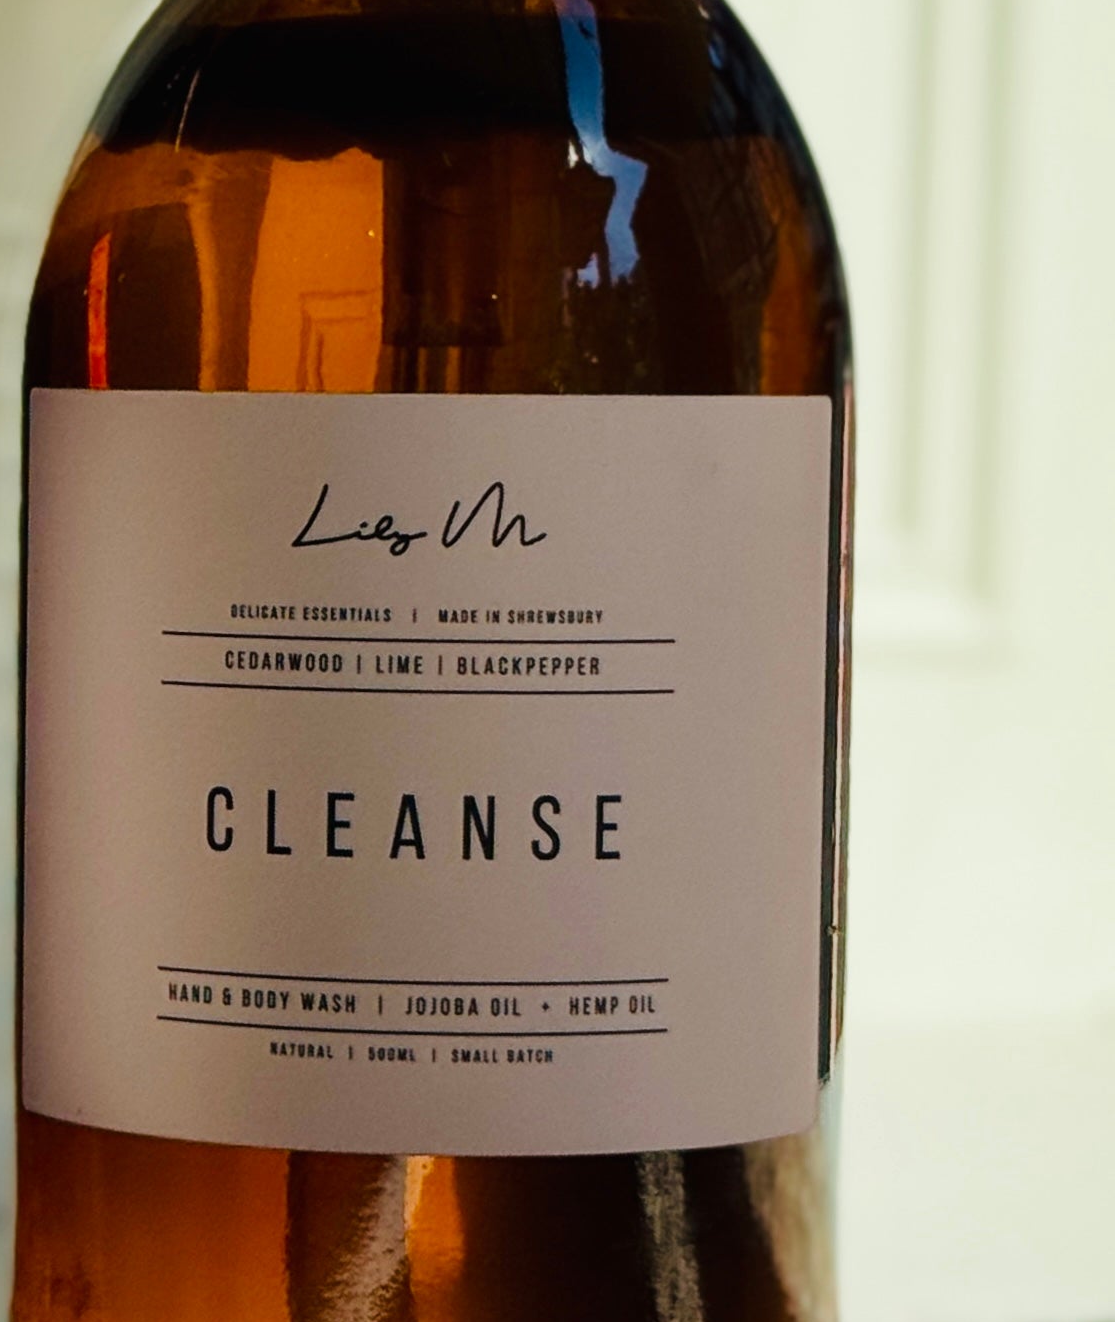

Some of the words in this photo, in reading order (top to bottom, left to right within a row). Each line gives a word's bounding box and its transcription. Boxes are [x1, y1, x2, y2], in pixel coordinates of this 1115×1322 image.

[291, 483, 428, 557] Lily
[231, 603, 296, 621] DELICATE
[303, 606, 392, 623] ESSENTIALS
[438, 609, 478, 624] MADE
[486, 609, 501, 624] IN
[507, 609, 603, 625] SHREWSBURY
[225, 650, 344, 673] CEDARWOOD
[375, 654, 423, 675] LIME
[456, 656, 600, 676] BLACKPEPPER
[206, 786, 622, 861] CLEANSE
[169, 982, 213, 1005] HAND
[222, 987, 233, 1006] &
[242, 988, 291, 1010] BODY
[300, 992, 358, 1014] WASH
[405, 996, 479, 1016] JOJOBA
[490, 997, 522, 1017] OIL
[569, 996, 619, 1016] HEMP
[629, 995, 656, 1015] OIL
[270, 1041, 334, 1060] NATURAL
[368, 1046, 416, 1064] 500ML
[451, 1048, 499, 1064] SMALL
[506, 1048, 553, 1064] BATCH
